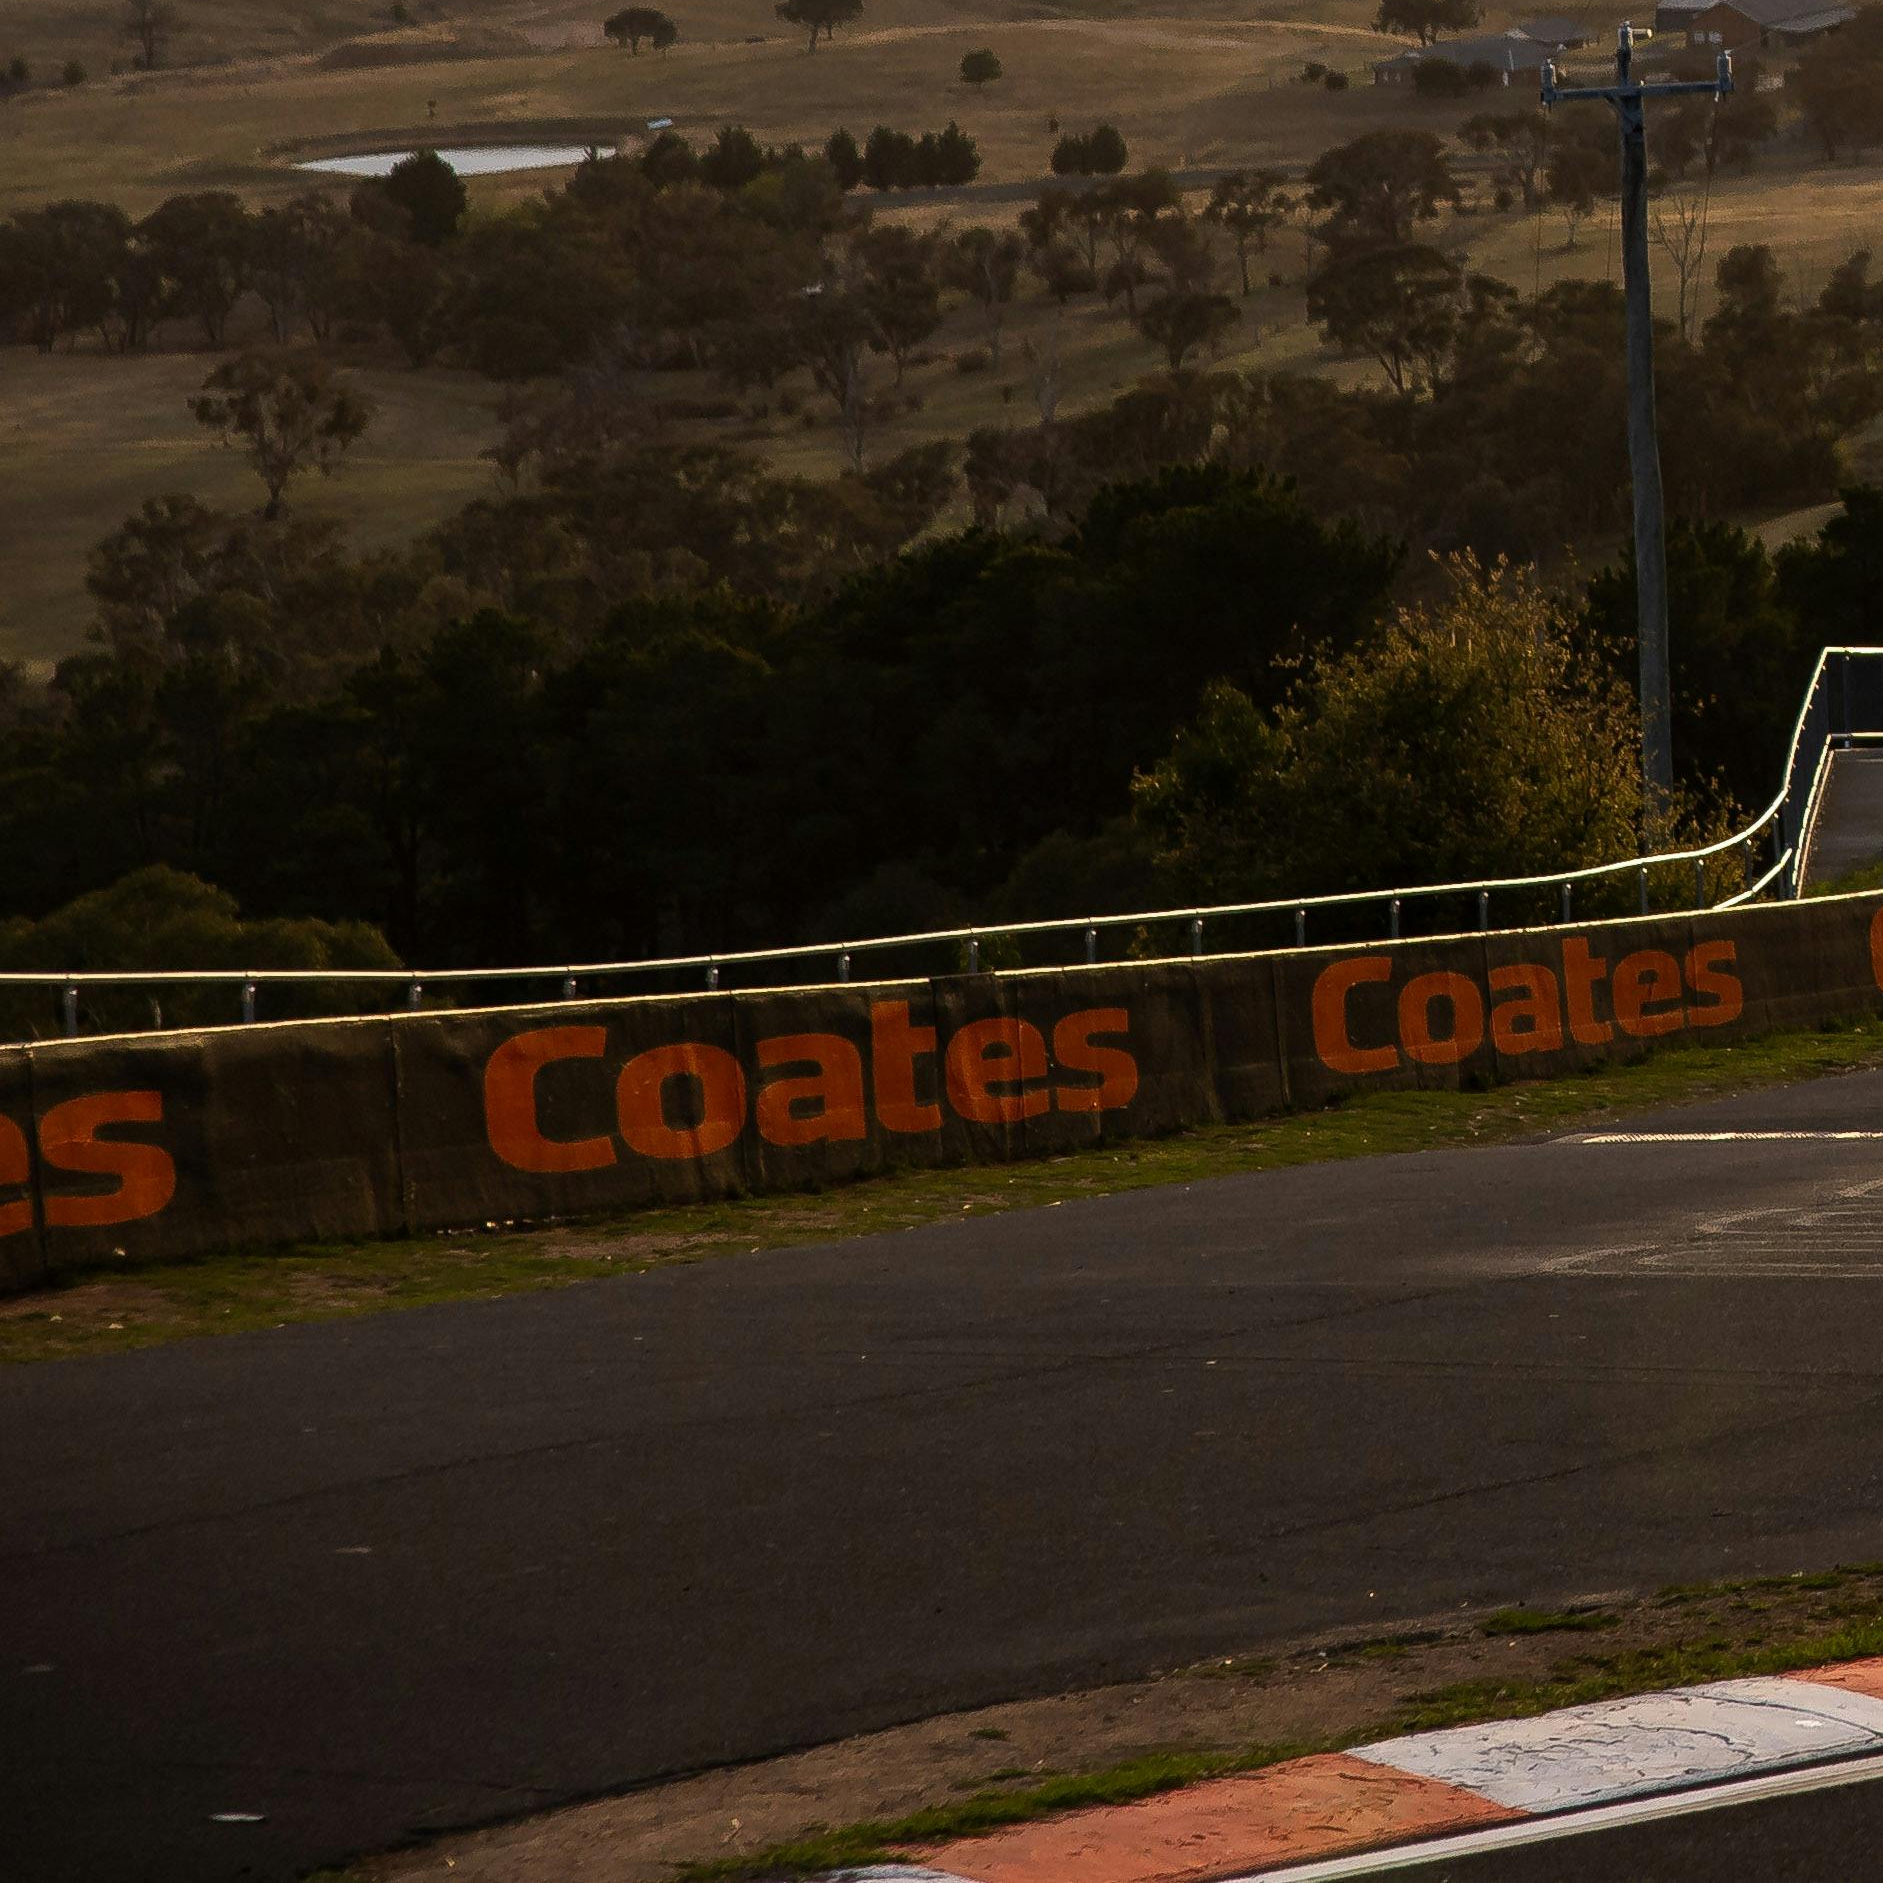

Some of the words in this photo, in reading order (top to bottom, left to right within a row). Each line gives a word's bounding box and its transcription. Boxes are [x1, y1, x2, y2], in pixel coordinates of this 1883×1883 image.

[1312, 937, 1744, 1075] Coates
[483, 998, 1140, 1174] Coates
[0, 1090, 176, 1236] s
